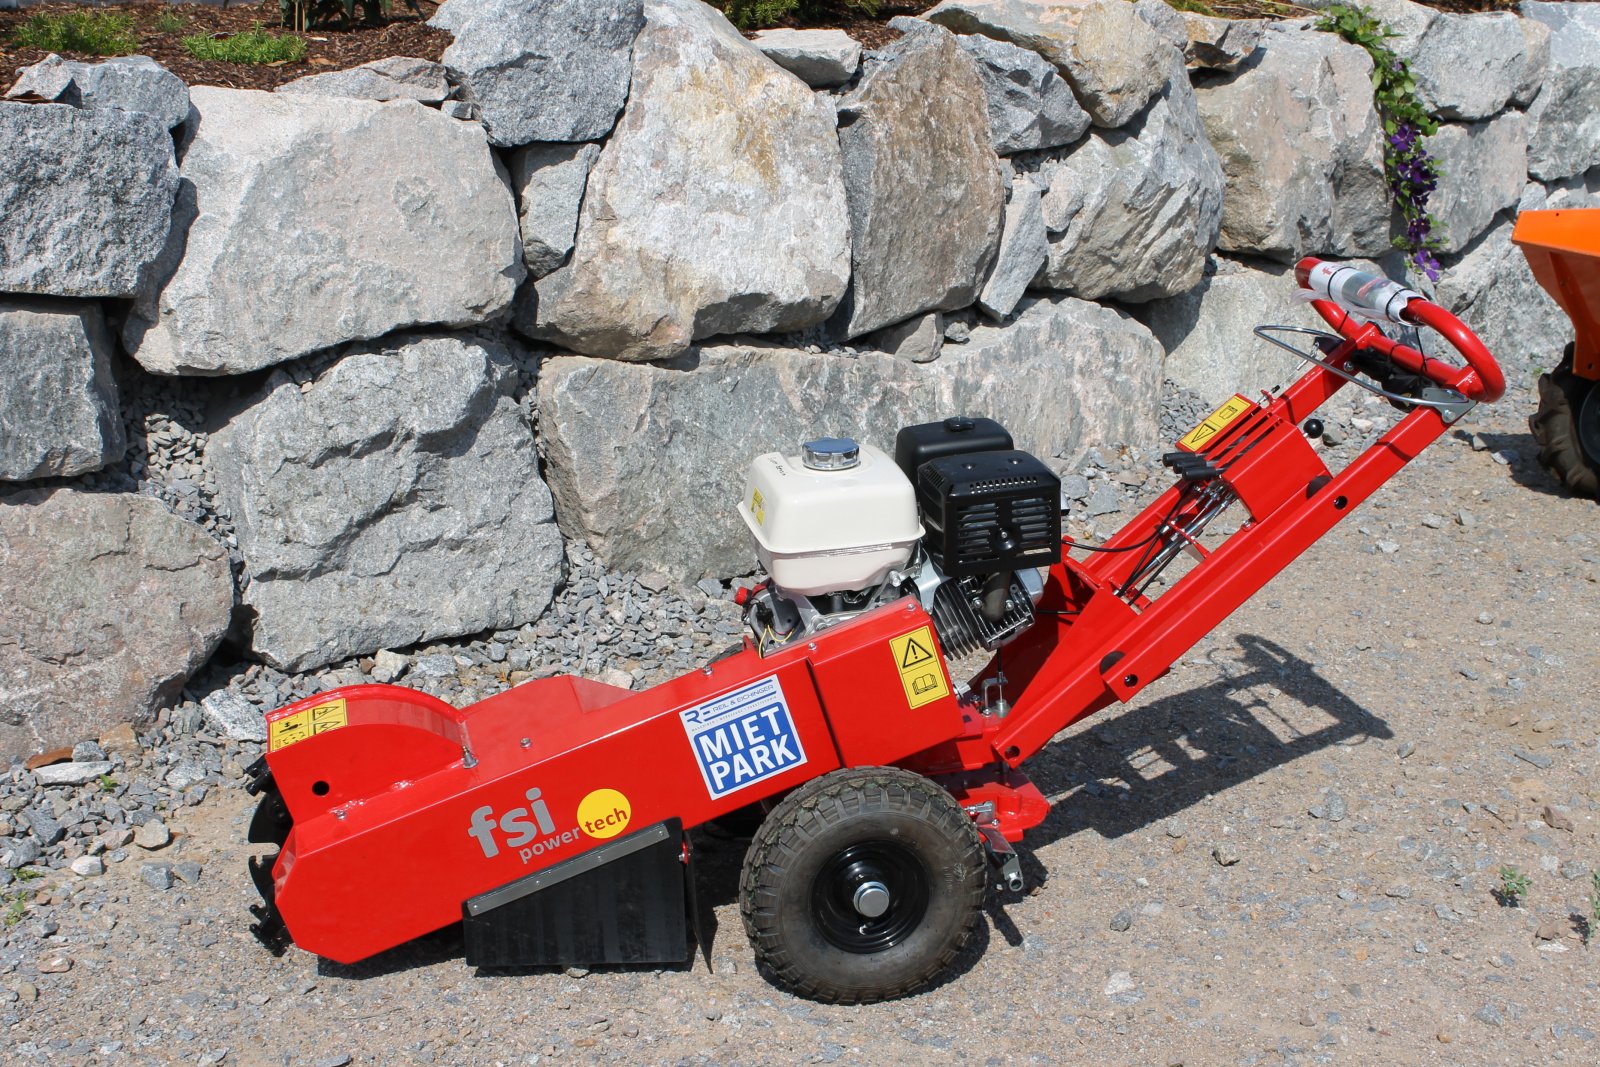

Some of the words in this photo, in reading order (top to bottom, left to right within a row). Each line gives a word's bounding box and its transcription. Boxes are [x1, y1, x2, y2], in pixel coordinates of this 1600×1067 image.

[712, 704, 729, 713] REIL
[737, 684, 774, 703] EICHINGER
[699, 706, 781, 763] MIET
[709, 734, 797, 790] PARK
[468, 787, 556, 858] fsi
[519, 827, 580, 864] power
[585, 808, 628, 834] tech
